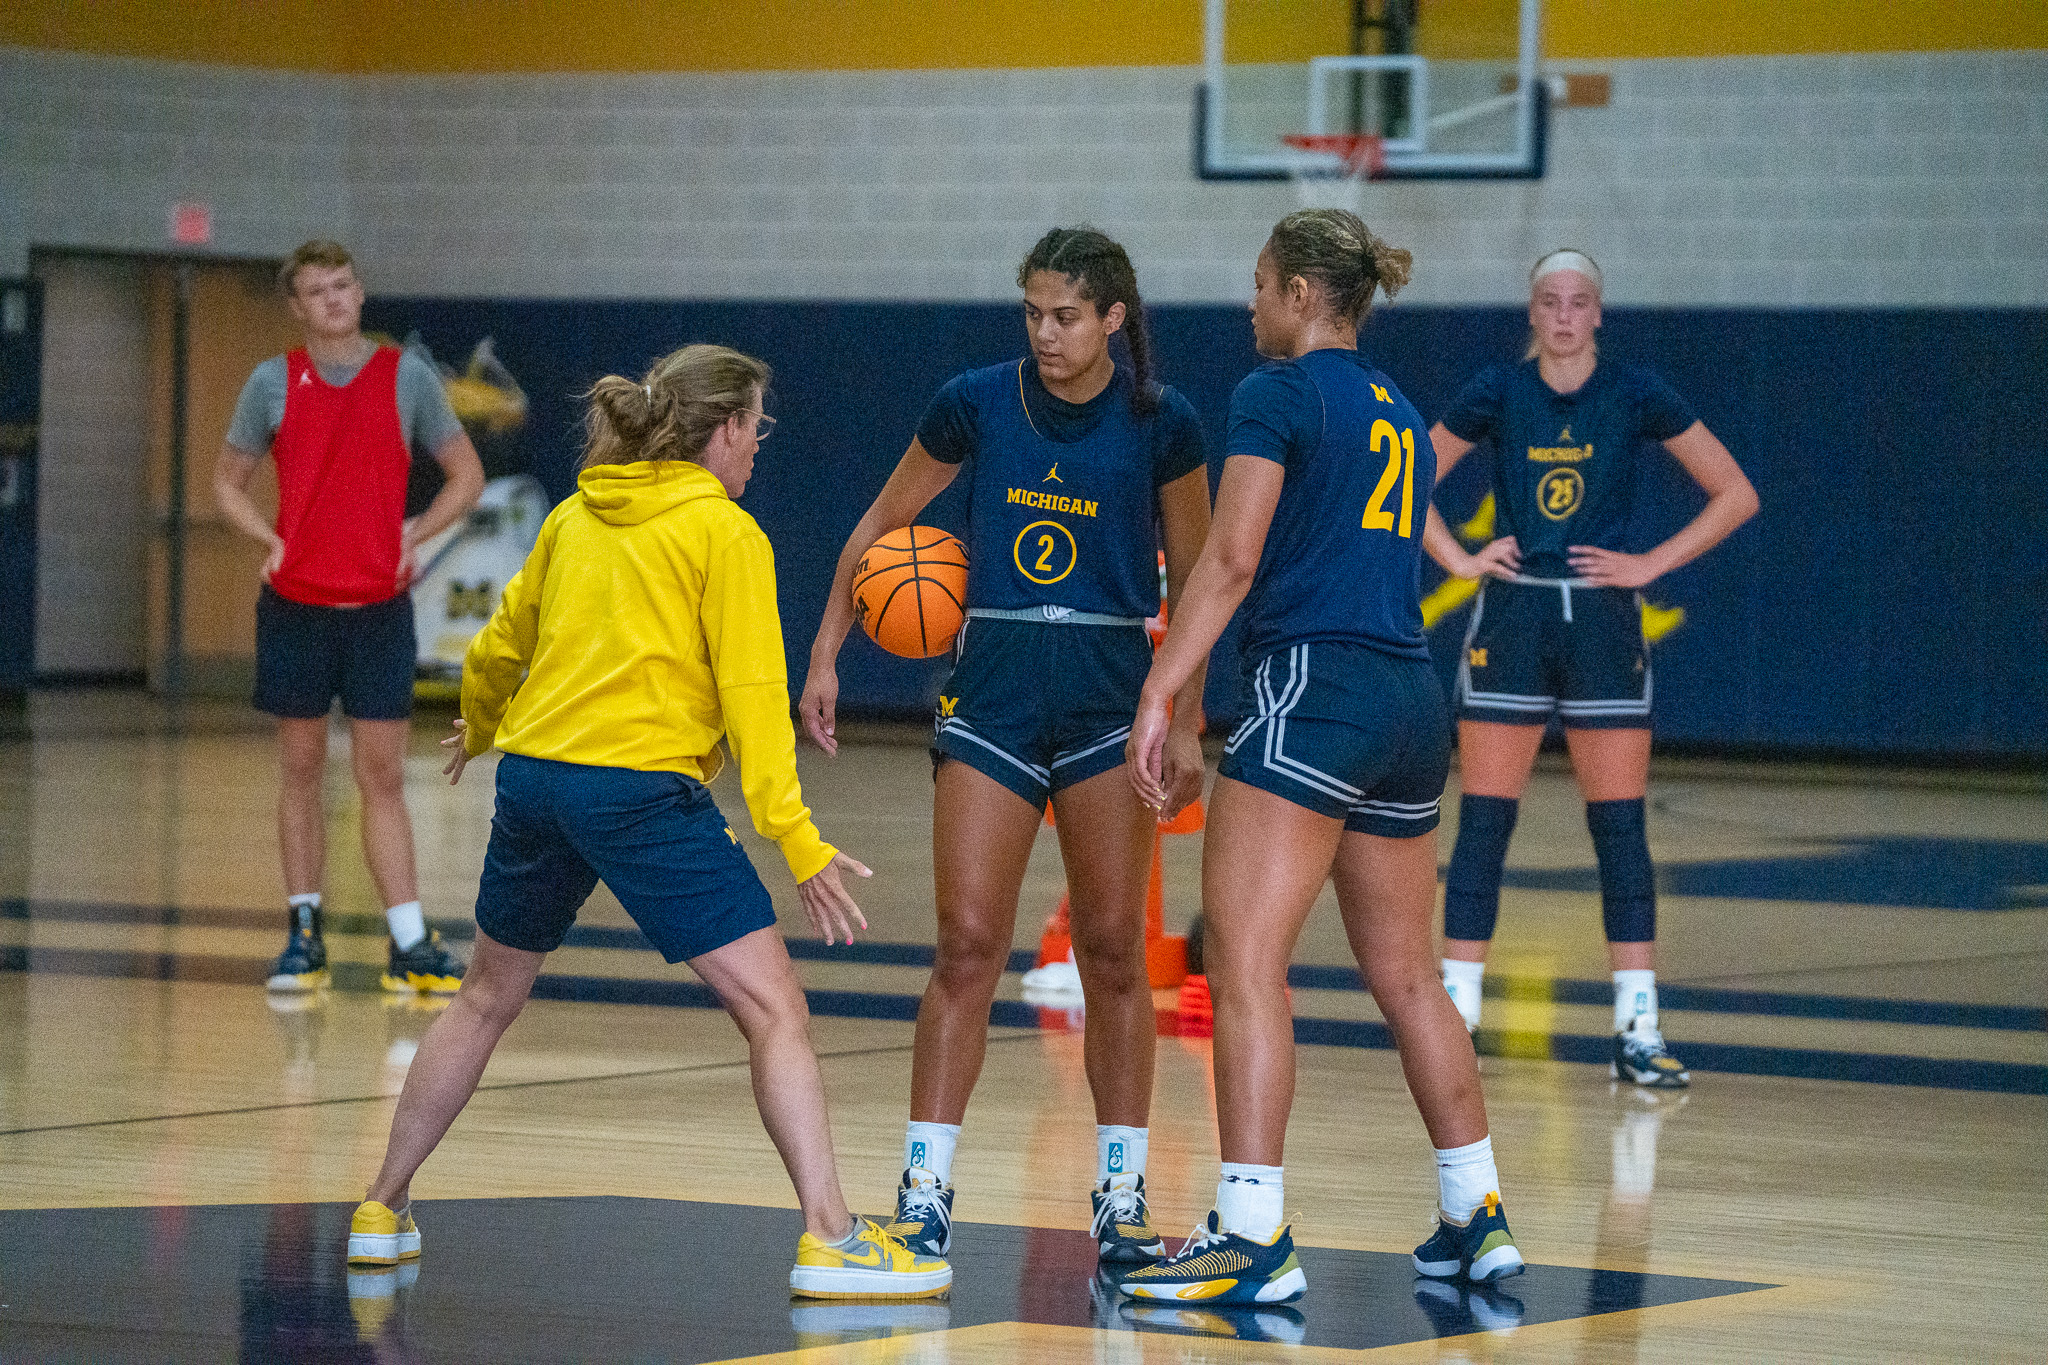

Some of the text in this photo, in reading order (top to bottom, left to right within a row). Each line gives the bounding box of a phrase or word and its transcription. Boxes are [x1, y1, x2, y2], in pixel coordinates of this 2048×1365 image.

[1369, 383, 1394, 404] M
[1361, 419, 1415, 538] 21
[1007, 488, 1099, 517] MICHIGAN
[1548, 478, 1575, 510] 25
[1035, 534, 1055, 572] 2
[448, 579, 491, 619] M
[1470, 649, 1487, 667] M
[939, 695, 959, 717] M
